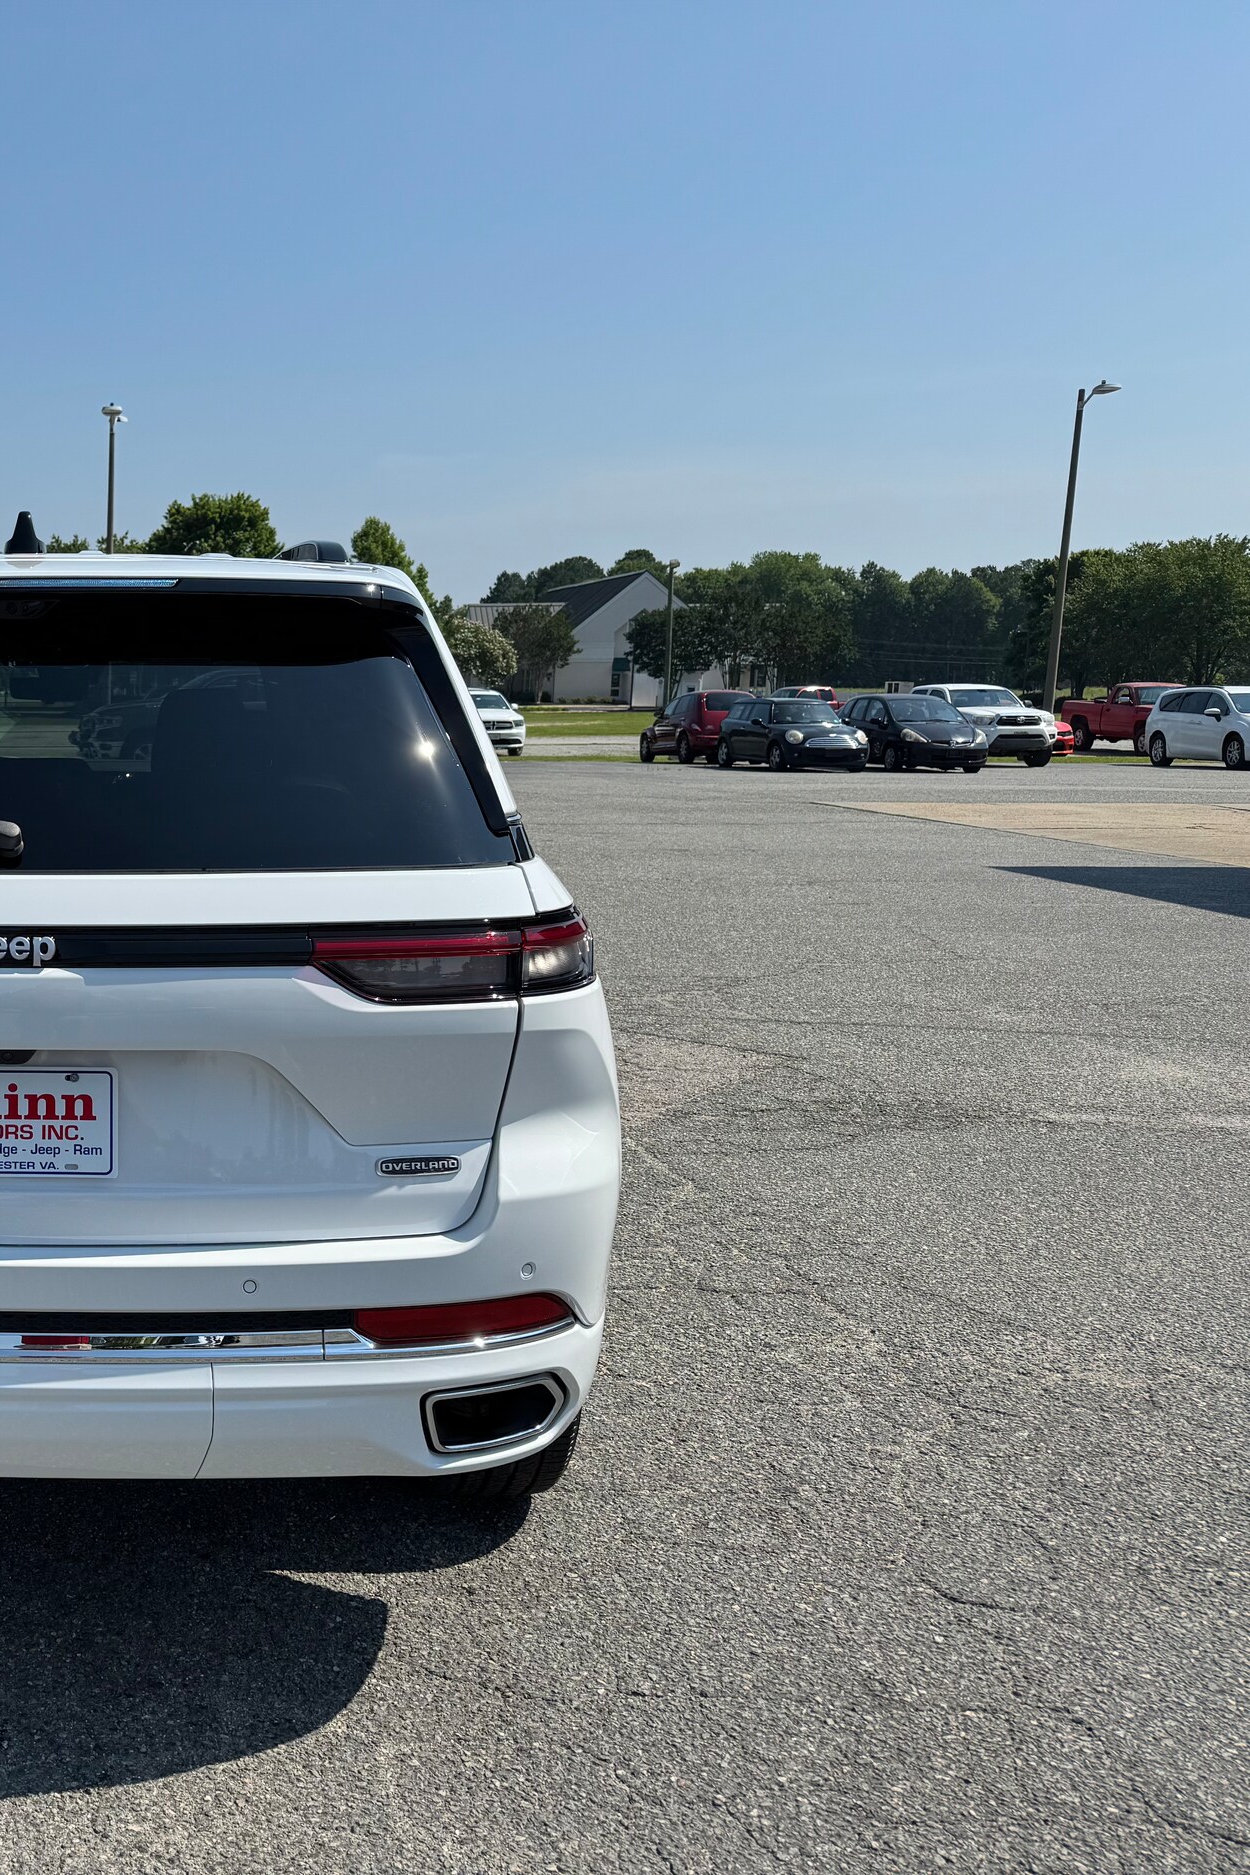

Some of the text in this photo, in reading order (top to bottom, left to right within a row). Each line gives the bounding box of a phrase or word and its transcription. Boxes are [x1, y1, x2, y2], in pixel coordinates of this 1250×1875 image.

[41, 1124, 84, 1141] INC.
[30, 1143, 61, 1157] Jeep
[73, 1144, 102, 1156] Ram
[39, 1161, 59, 1170] VA.
[381, 1159, 458, 1172] OVERLAND
